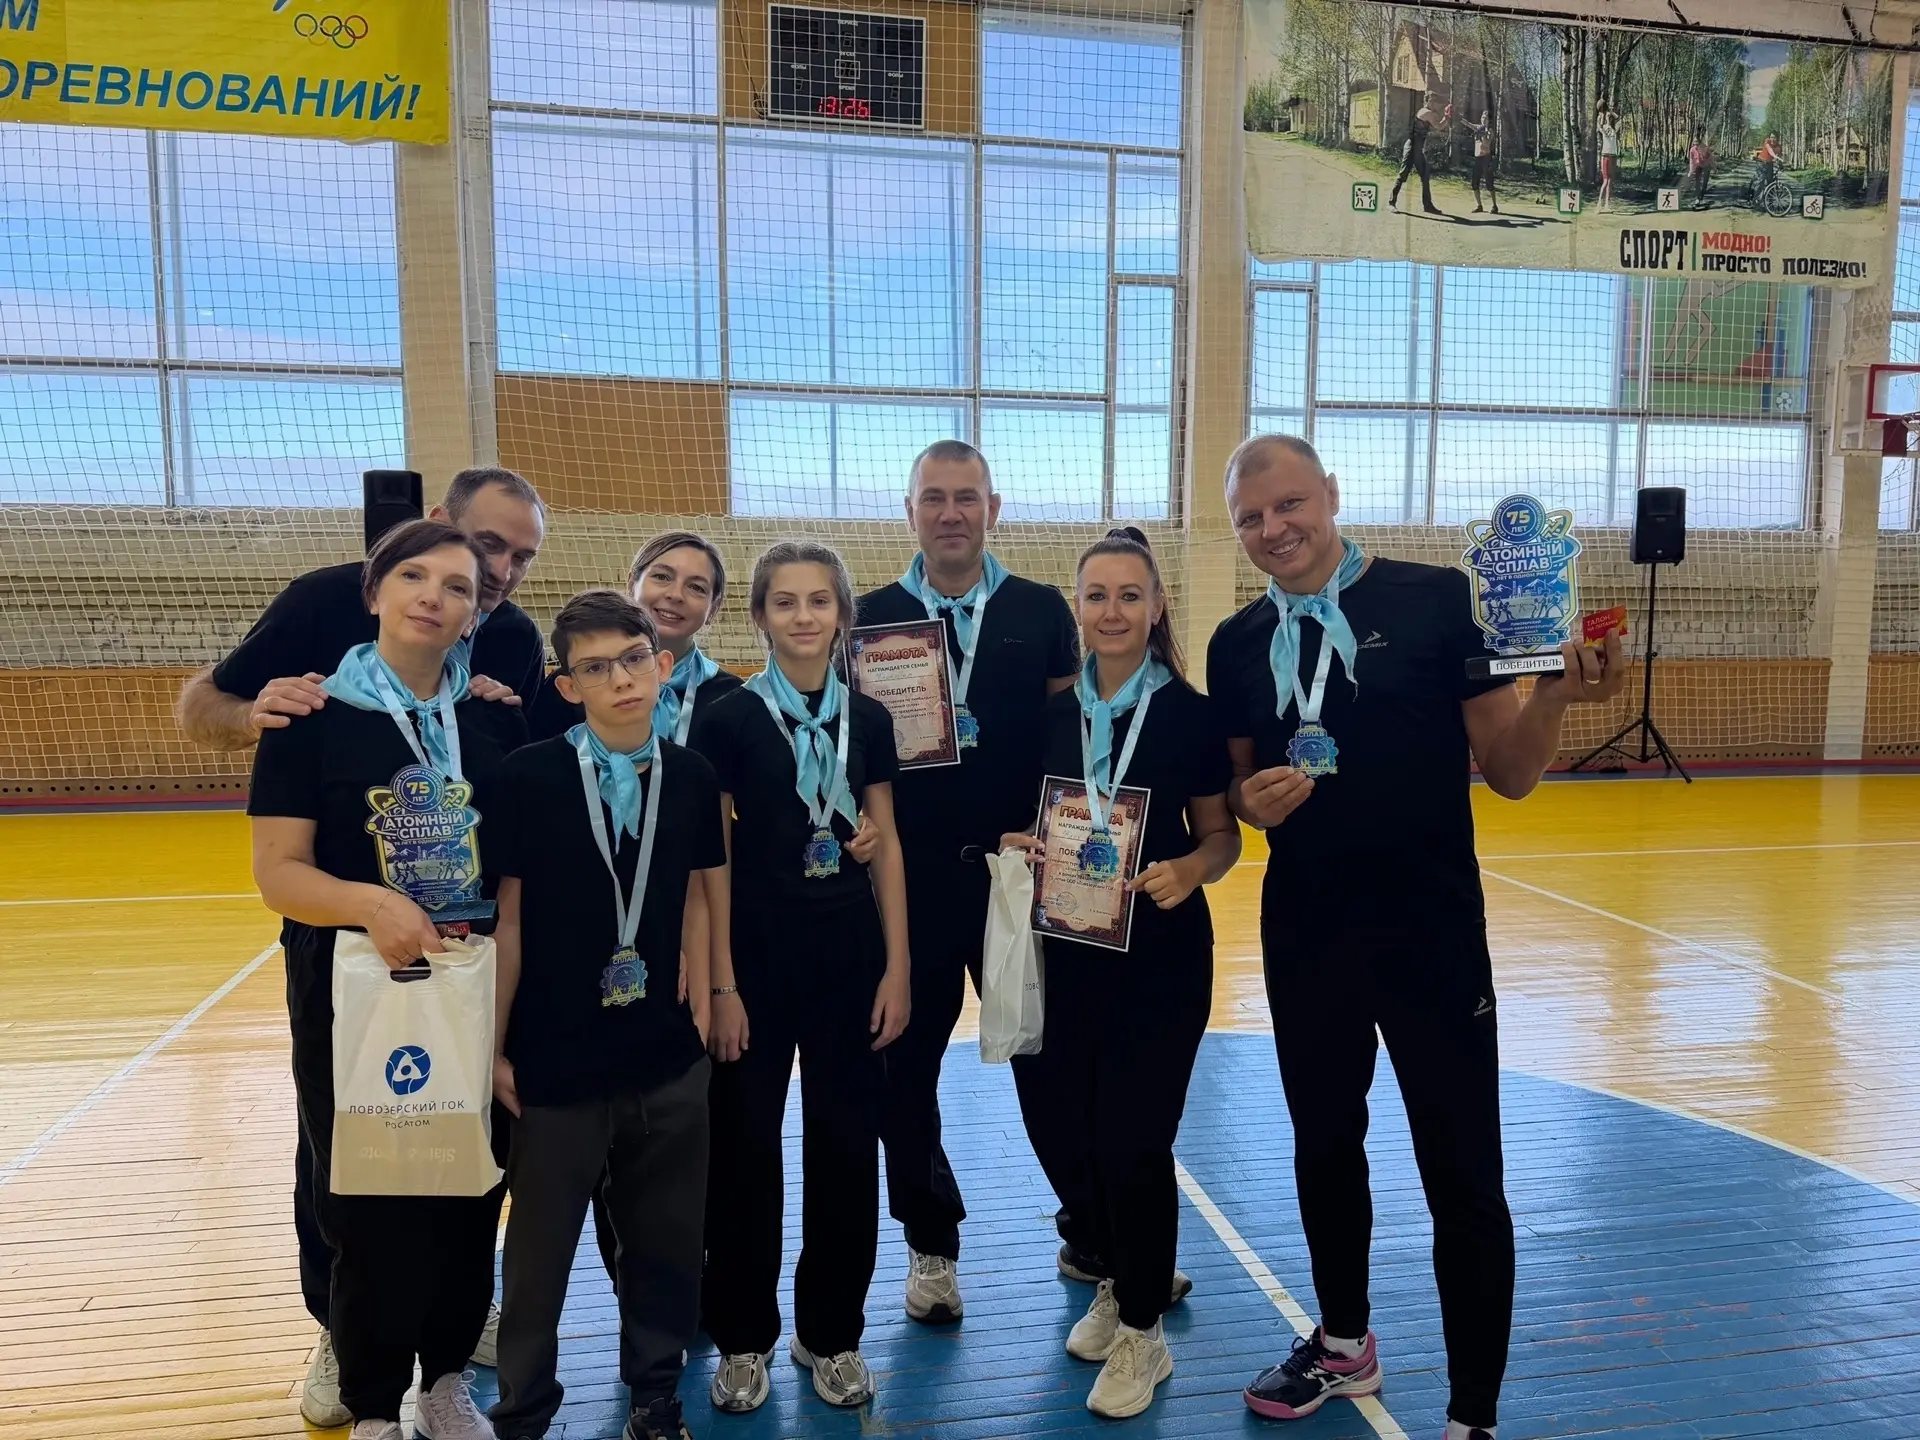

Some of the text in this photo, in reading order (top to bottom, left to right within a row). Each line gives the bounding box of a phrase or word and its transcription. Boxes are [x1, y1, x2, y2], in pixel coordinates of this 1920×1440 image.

[818, 96, 869, 117] 13:26
[1620, 230, 1688, 270] СПОРТ
[1701, 232, 1771, 253] МОДНО!
[1701, 254, 1867, 278] ПРОСТО ПОЛЕЗНО!
[1506, 510, 1530, 525] 75
[1481, 540, 1563, 563] АТОМНЫЙ
[1495, 557, 1550, 574] СПЛАВ
[1587, 615, 1610, 627] ТАЛОН
[1508, 636, 1547, 645] 1951-2026
[865, 647, 928, 663] ГРАМОТА
[867, 664, 910, 673] НАГРАЖДАЕТСЯ
[1496, 658, 1562, 670] ПОБЕДИТЕЛЬ
[875, 685, 927, 697] ПОБЕДИТЕЛЬ
[406, 782, 430, 795] 75
[385, 810, 464, 829] АТОМНЫЙ
[1060, 805, 1123, 826] ГРАМТА
[399, 825, 452, 839] СПЛАВ
[349, 1100, 465, 1115] ЛОВОЗЕРСКИЙ ГОК
[385, 1119, 431, 1129] РОСАТОМ
